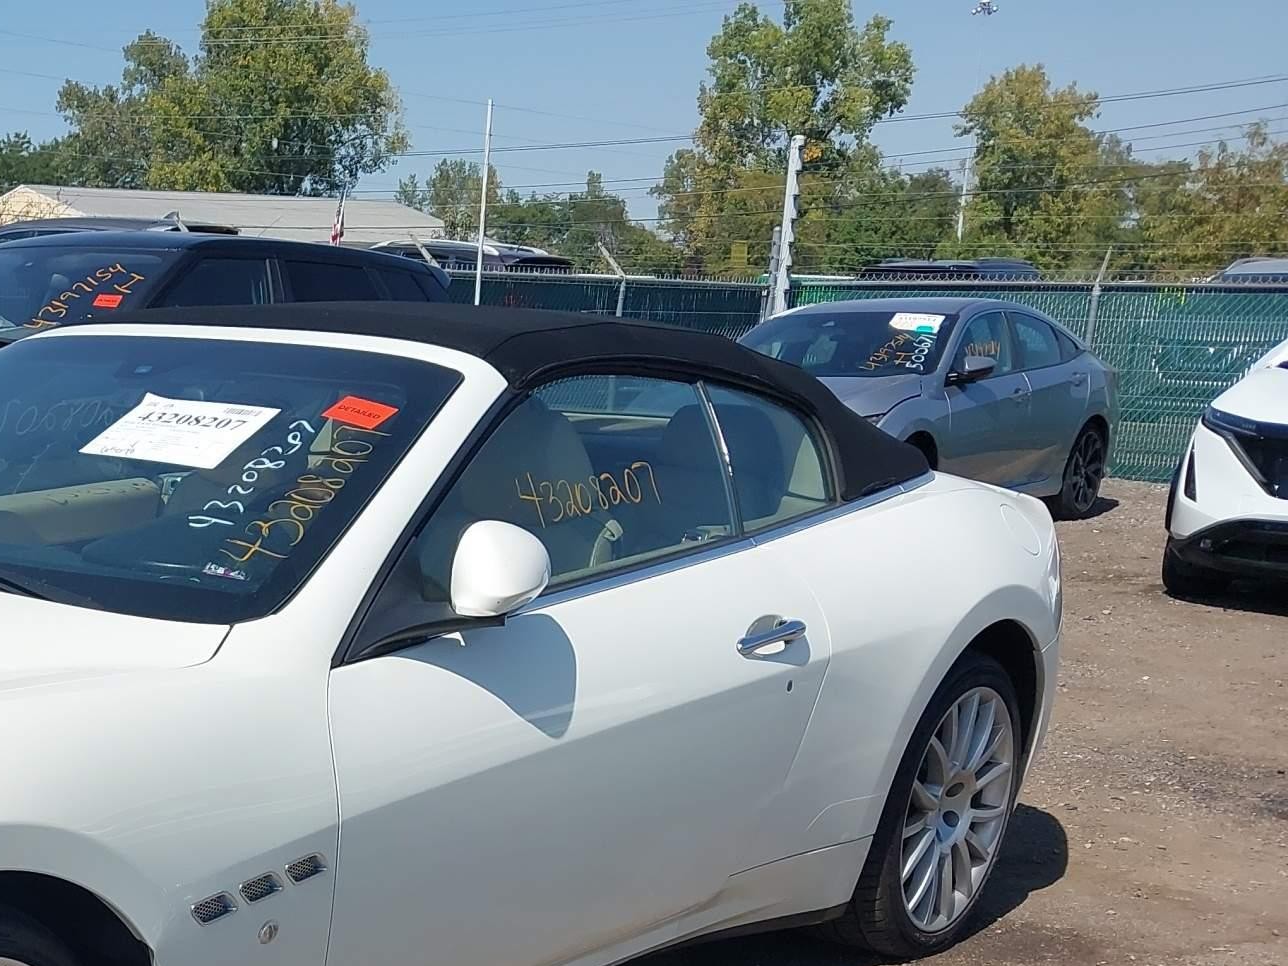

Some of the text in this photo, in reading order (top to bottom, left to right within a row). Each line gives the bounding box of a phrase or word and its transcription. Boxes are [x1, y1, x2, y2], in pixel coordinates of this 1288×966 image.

[23, 263, 128, 329] 43197154
[137, 411, 249, 431] 43208207
[338, 404, 381, 420] DETAILED
[188, 420, 315, 528] 43208207
[219, 425, 393, 562] 43208207
[515, 460, 661, 529] 43208207
